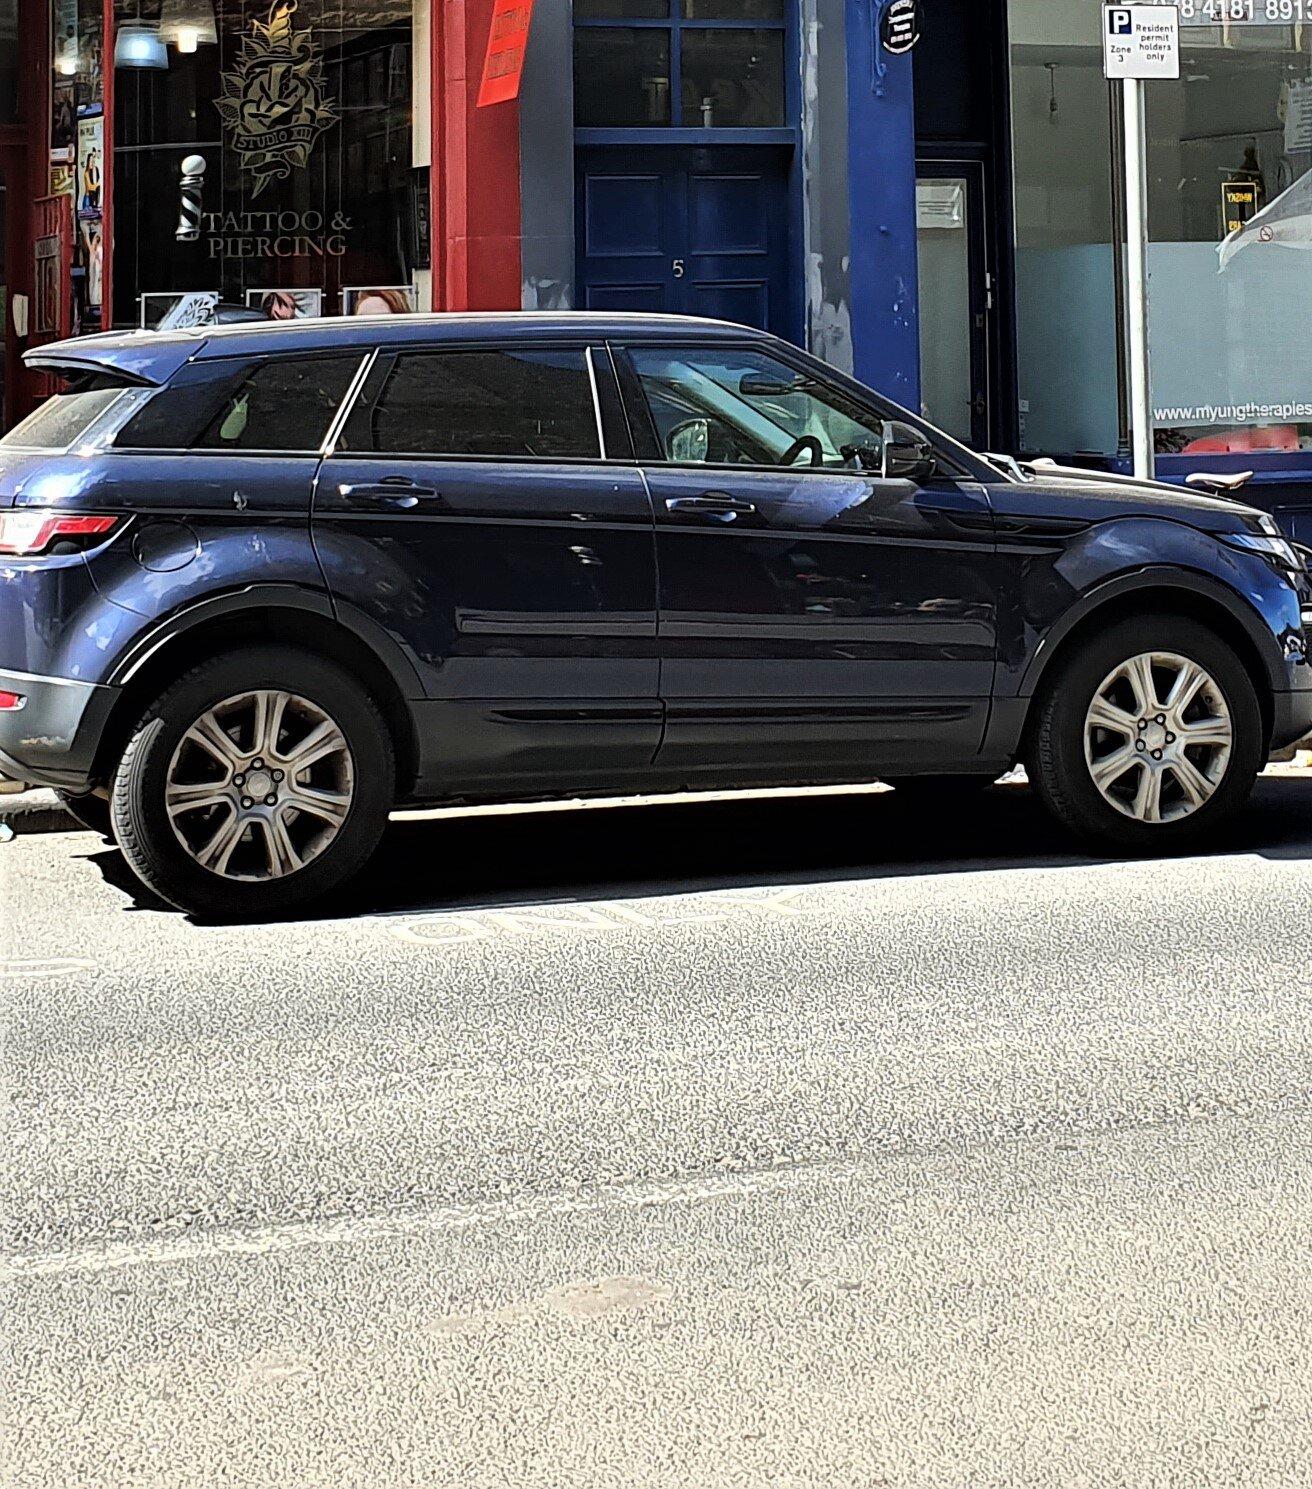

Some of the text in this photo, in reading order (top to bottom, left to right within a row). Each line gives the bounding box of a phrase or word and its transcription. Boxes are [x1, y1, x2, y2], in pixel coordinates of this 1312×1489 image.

[1113, 11, 1130, 34] P
[1136, 24, 1174, 33] Resident
[1141, 35, 1169, 43] permit
[1110, 45, 1132, 53] Zone
[1139, 43, 1172, 51] holders
[1118, 54, 1124, 63] 3
[1146, 54, 1165, 62] only
[237, 130, 288, 149] STUDIO
[202, 211, 354, 233] TATTOO &
[207, 235, 348, 258] PIERCING
[672, 259, 684, 278] 5
